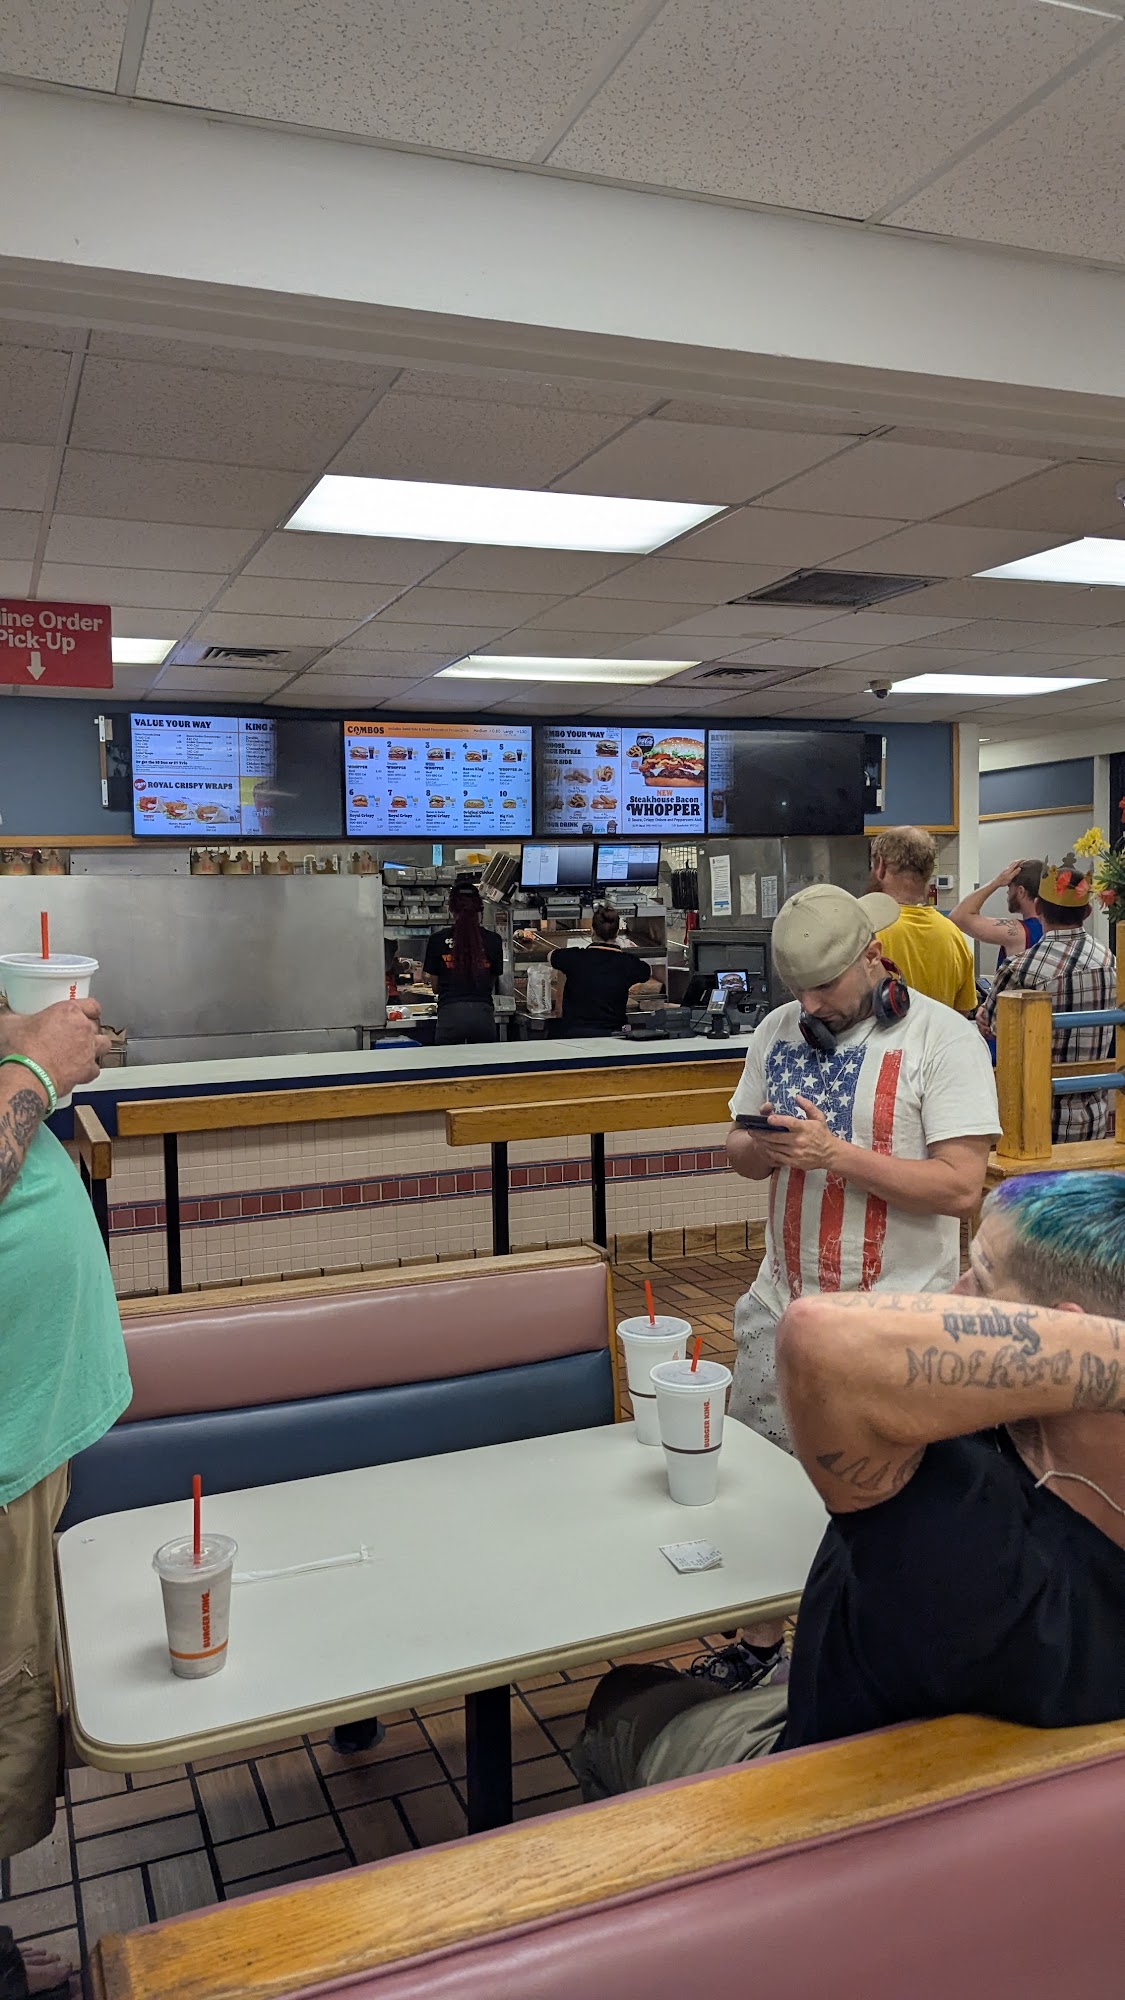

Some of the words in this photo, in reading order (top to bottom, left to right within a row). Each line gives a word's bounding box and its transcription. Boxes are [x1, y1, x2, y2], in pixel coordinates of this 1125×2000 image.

[0, 607, 34, 628] ine
[39, 611, 103, 632] Order
[0, 628, 76, 655] Pick-Up
[134, 718, 166, 727] VALUE
[166, 719, 191, 728] YOUR
[192, 720, 212, 729] WAY
[245, 722, 268, 731] KING
[347, 725, 385, 735] COMBOS
[566, 730, 587, 738] YOUR
[147, 781, 174, 789] ROYAL
[174, 782, 204, 790] CRISPY
[626, 803, 701, 816] WHOPPER
[69, 984, 77, 1000] ING
[201, 1592, 210, 1614] KING
[202, 1615, 211, 1648] BURGER
